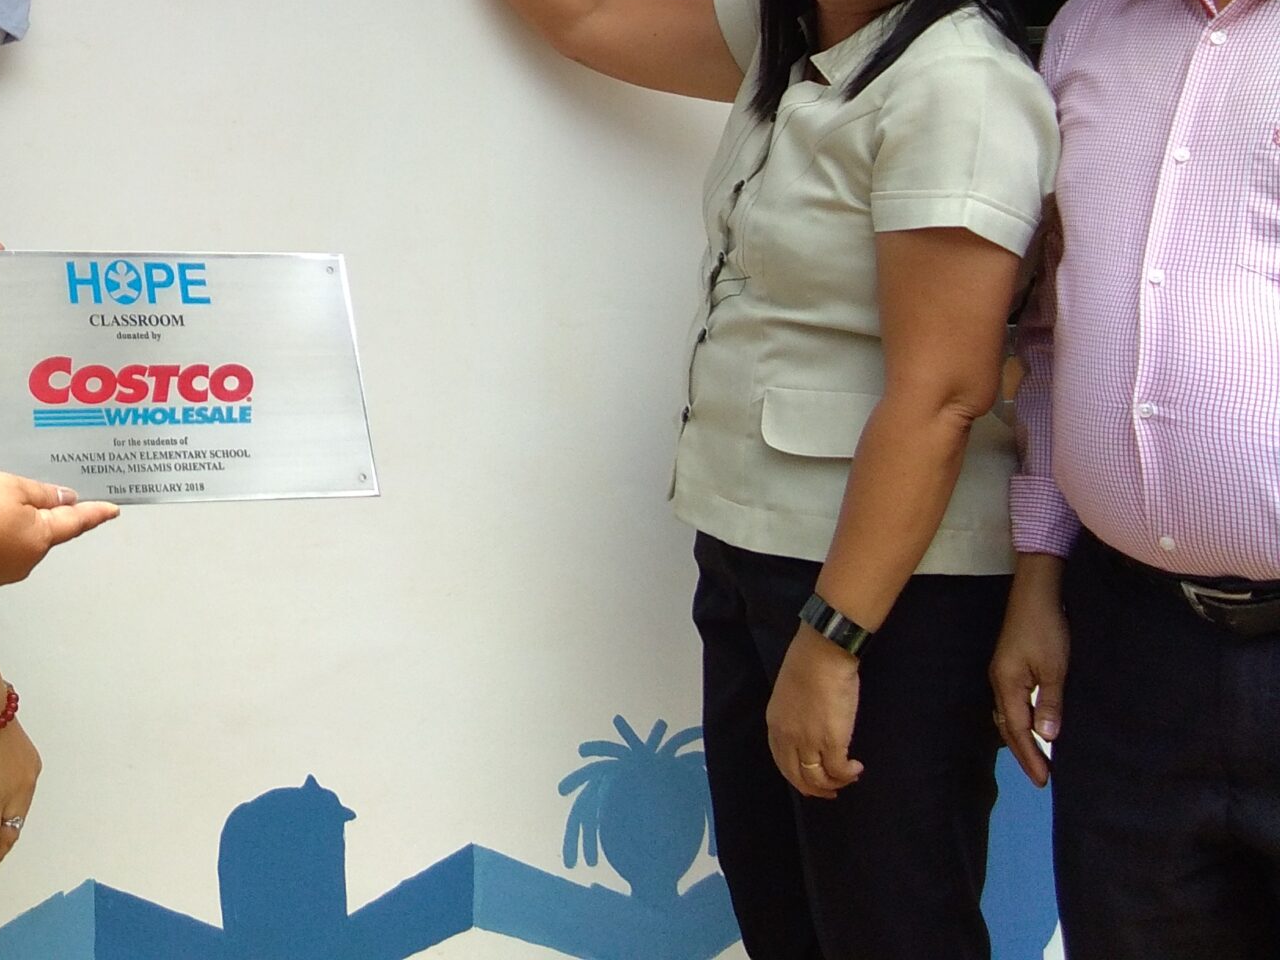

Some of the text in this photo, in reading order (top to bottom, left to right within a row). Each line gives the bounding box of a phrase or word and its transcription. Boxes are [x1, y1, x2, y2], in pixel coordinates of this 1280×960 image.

[65, 259, 211, 305] HOPE
[89, 314, 185, 327] CLASSROOM
[116, 331, 162, 342] donated by
[28, 356, 254, 404] COSTCO
[104, 406, 252, 426] WHOLESALE
[113, 436, 188, 447] for the students of
[50, 449, 251, 462] MANANUM DAAN ELEMENTARY SCHOOL
[81, 461, 225, 475] MEDINA, MISAMIS ORIENTAL
[106, 482, 205, 494] This FEBRUARY 2018
